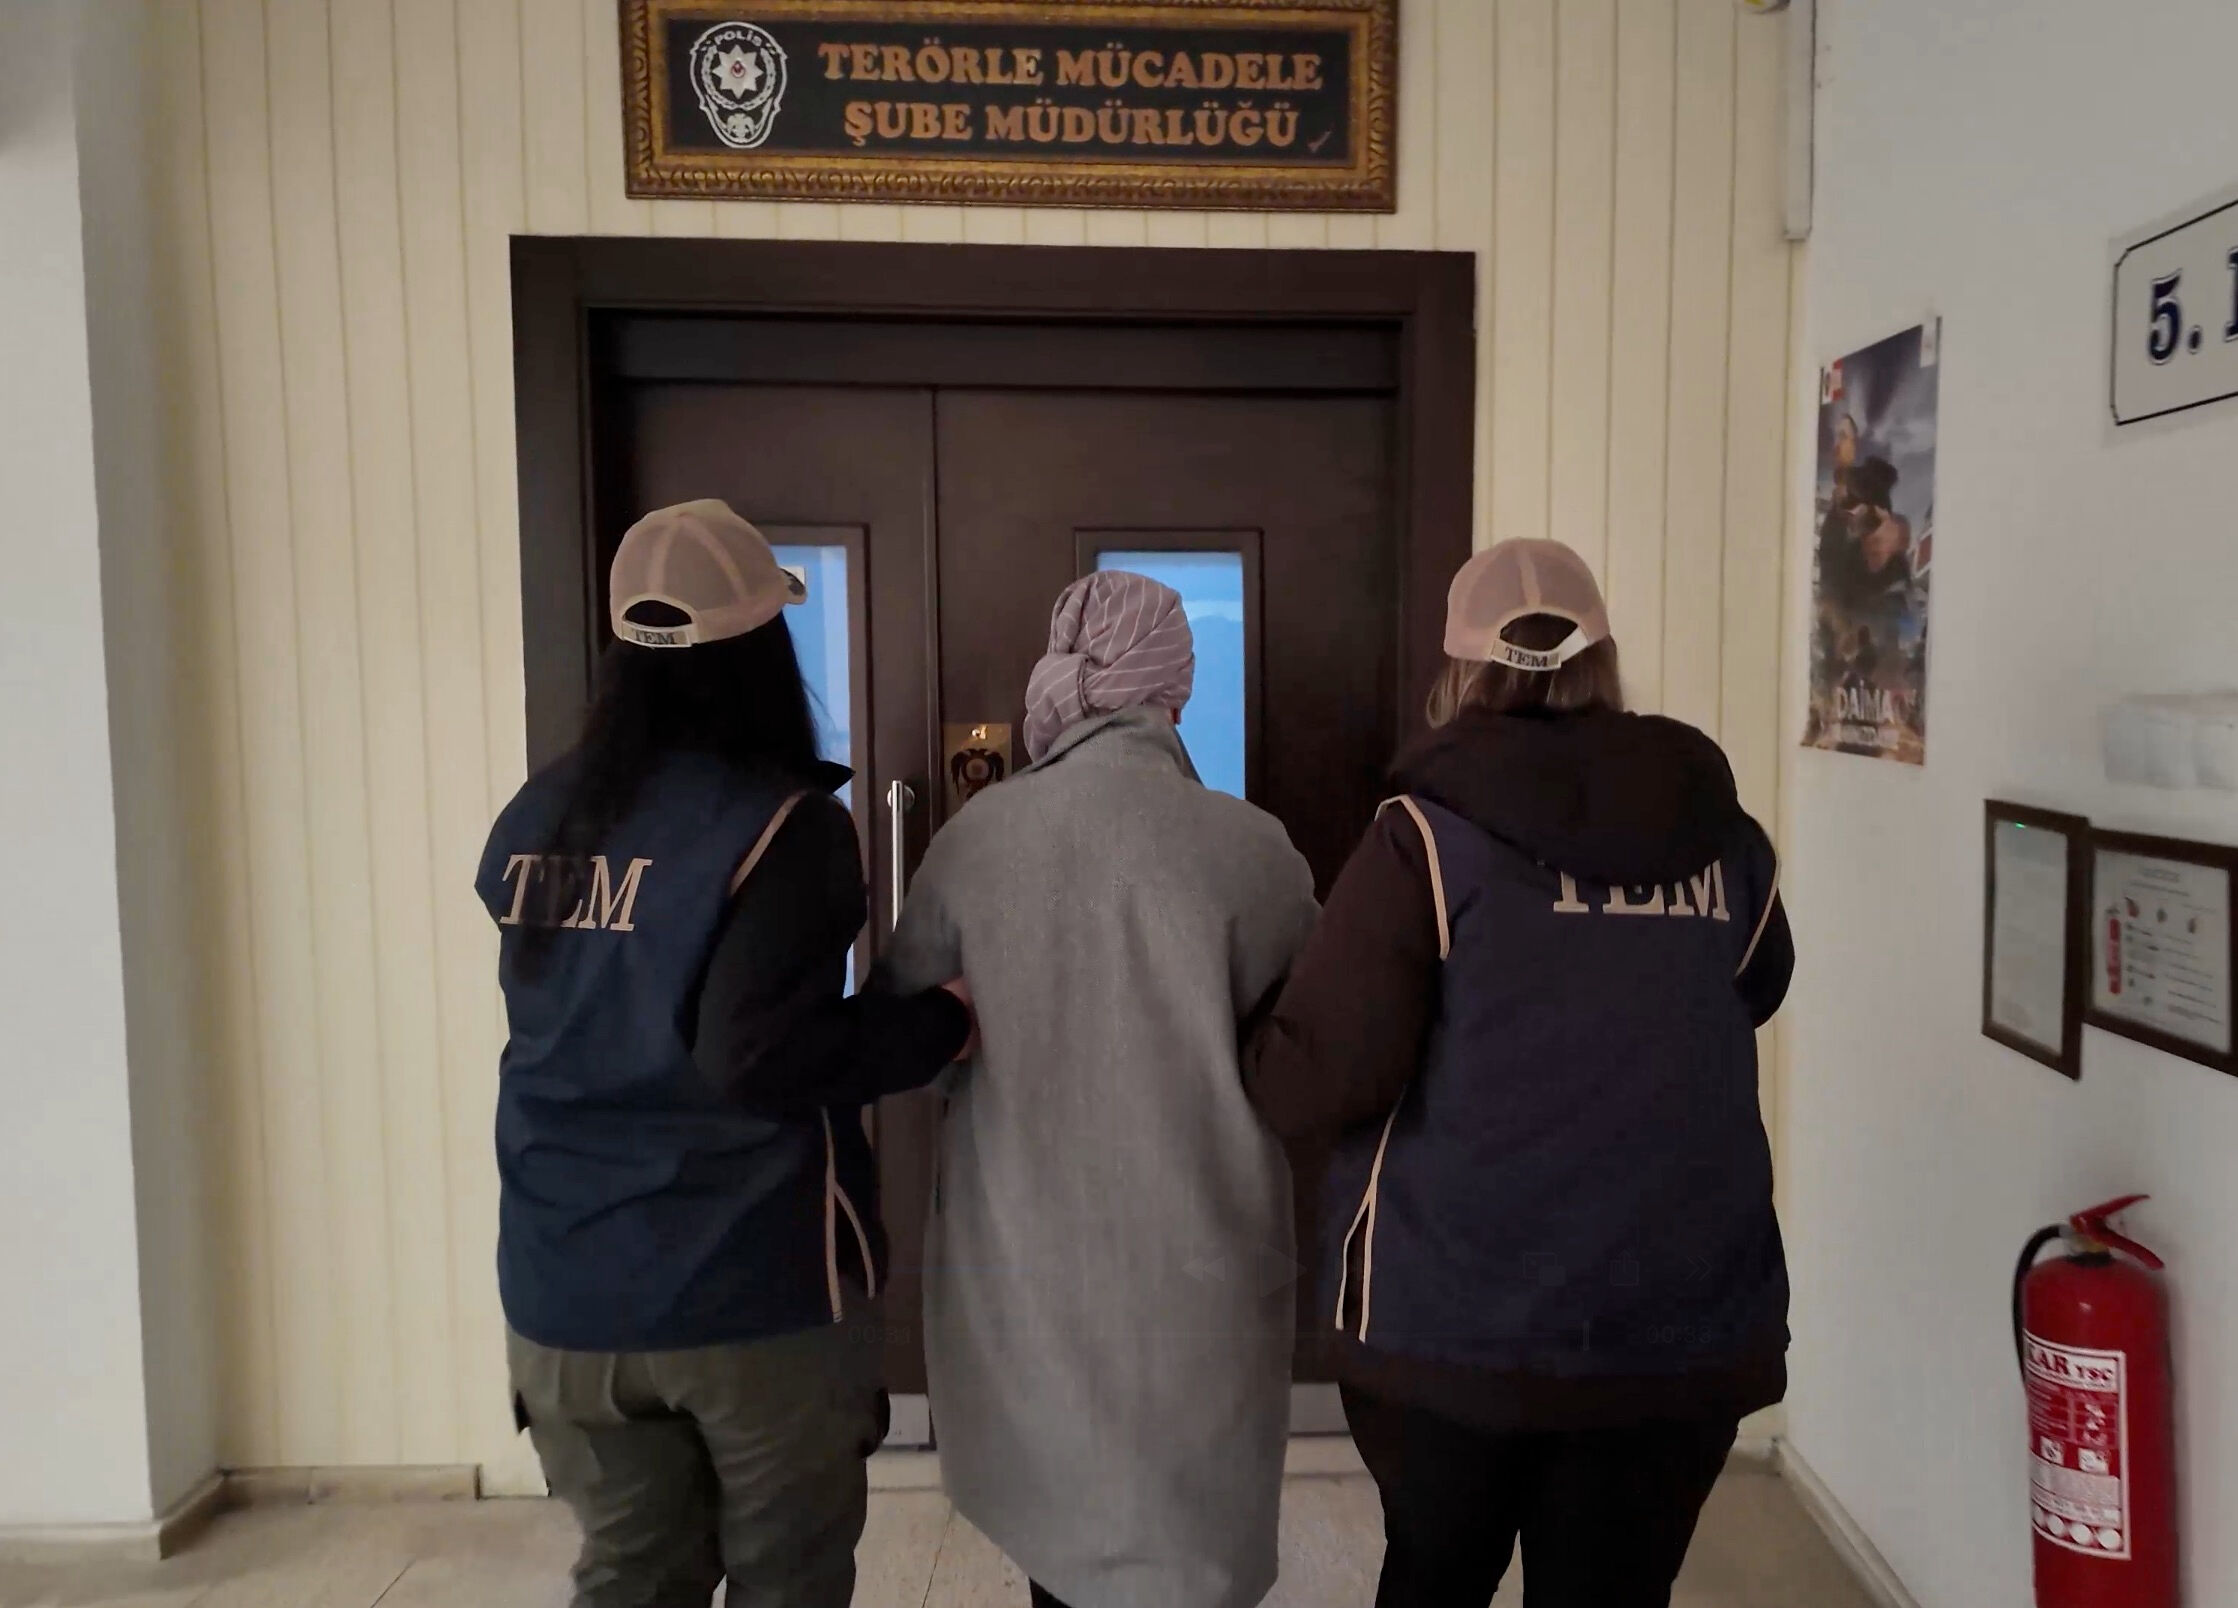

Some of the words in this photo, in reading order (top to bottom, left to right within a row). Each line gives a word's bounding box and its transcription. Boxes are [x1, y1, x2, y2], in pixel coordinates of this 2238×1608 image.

[818, 36, 1044, 85] TERÖRLE
[1056, 41, 1324, 90] MÜCADELE
[844, 100, 973, 147] ŞUBE
[985, 97, 1299, 147] MÜDÜRLÜĞÜ
[2148, 267, 2202, 363] 5.
[1505, 646, 1548, 667] TEM
[501, 854, 653, 931] TM
